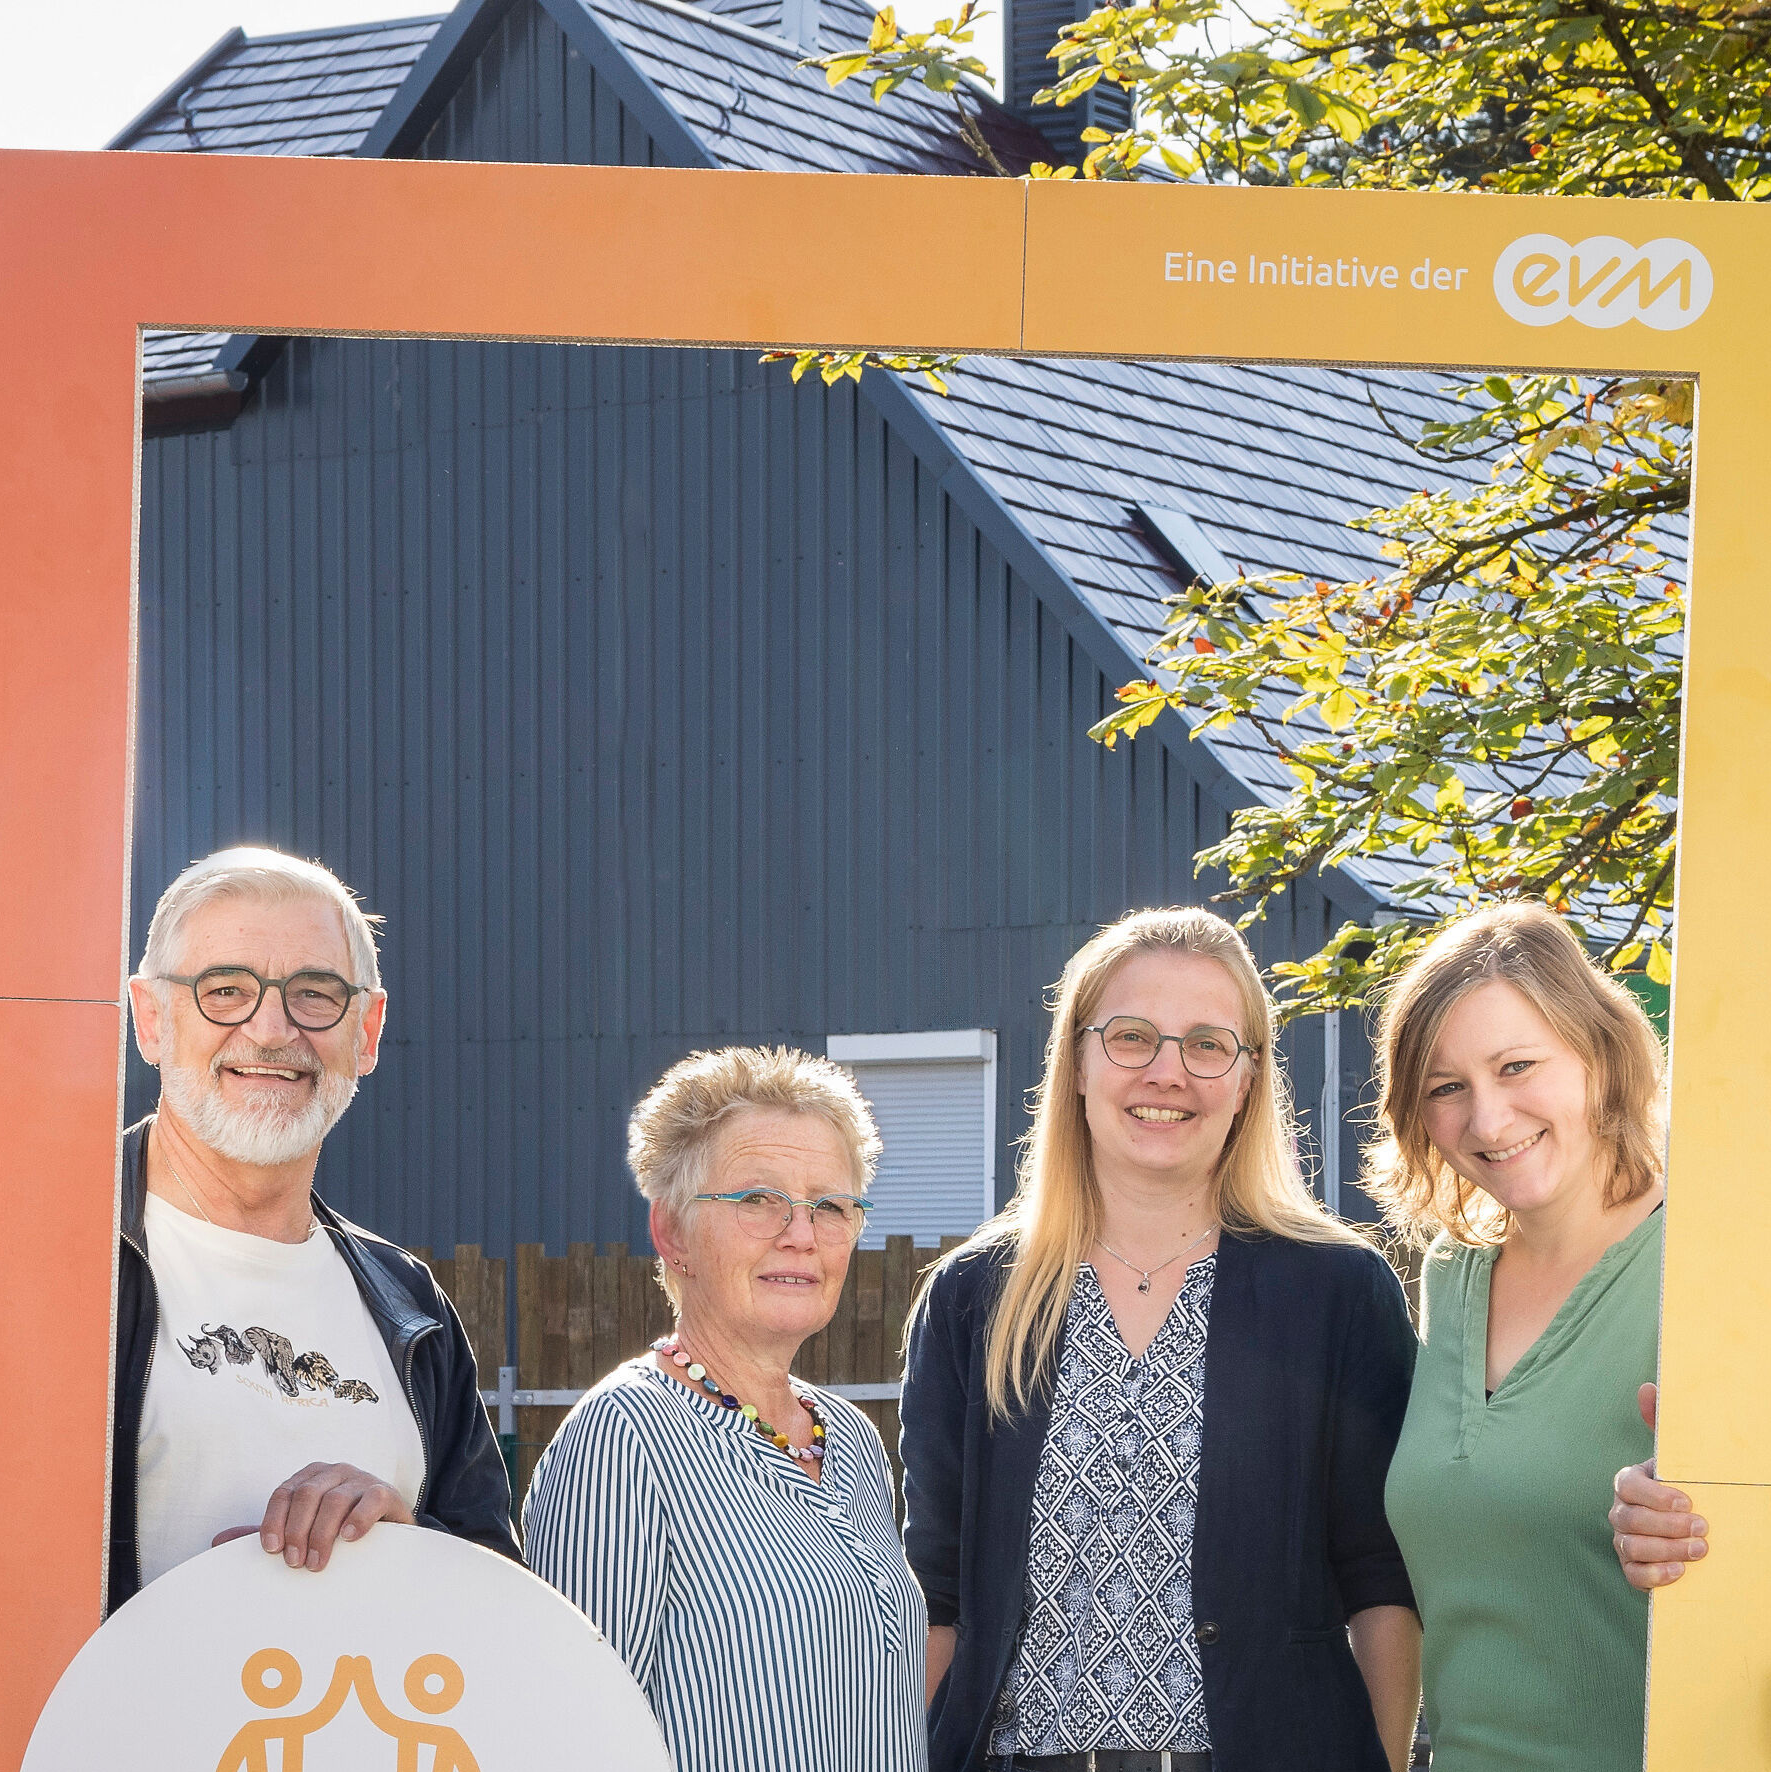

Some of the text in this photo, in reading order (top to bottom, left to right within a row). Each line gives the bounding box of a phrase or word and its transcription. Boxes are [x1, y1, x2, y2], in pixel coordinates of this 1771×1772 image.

[1164, 250, 1695, 314] Eine Initiative der evm
